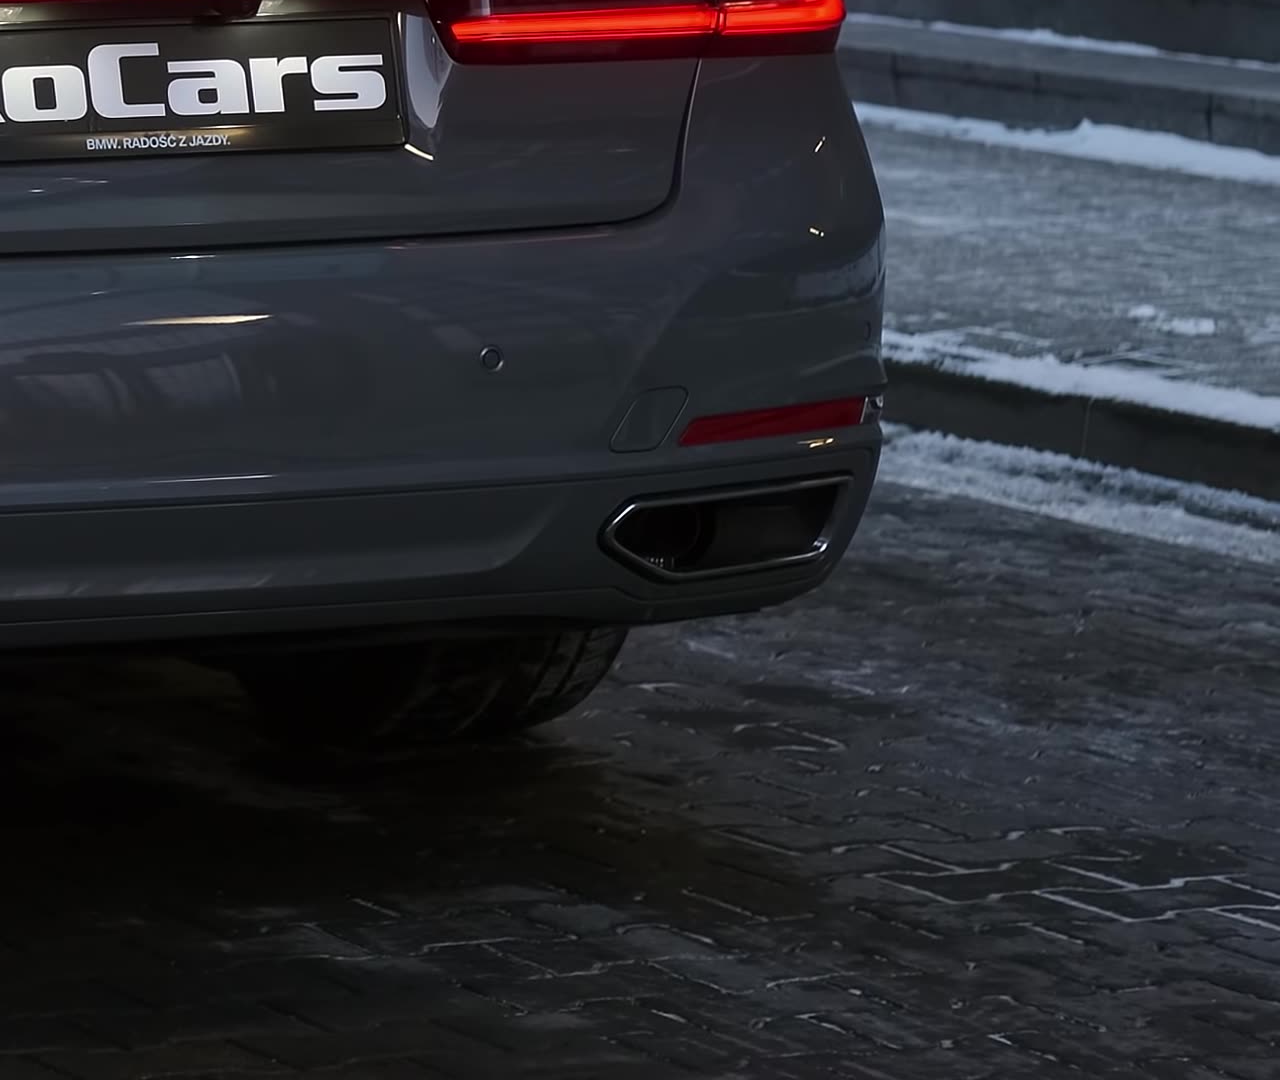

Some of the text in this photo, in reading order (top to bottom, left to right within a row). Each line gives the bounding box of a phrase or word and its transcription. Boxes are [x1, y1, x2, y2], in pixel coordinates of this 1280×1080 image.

[86, 134, 231, 150] BMW. RADOŚĆ Z JAZDY.
